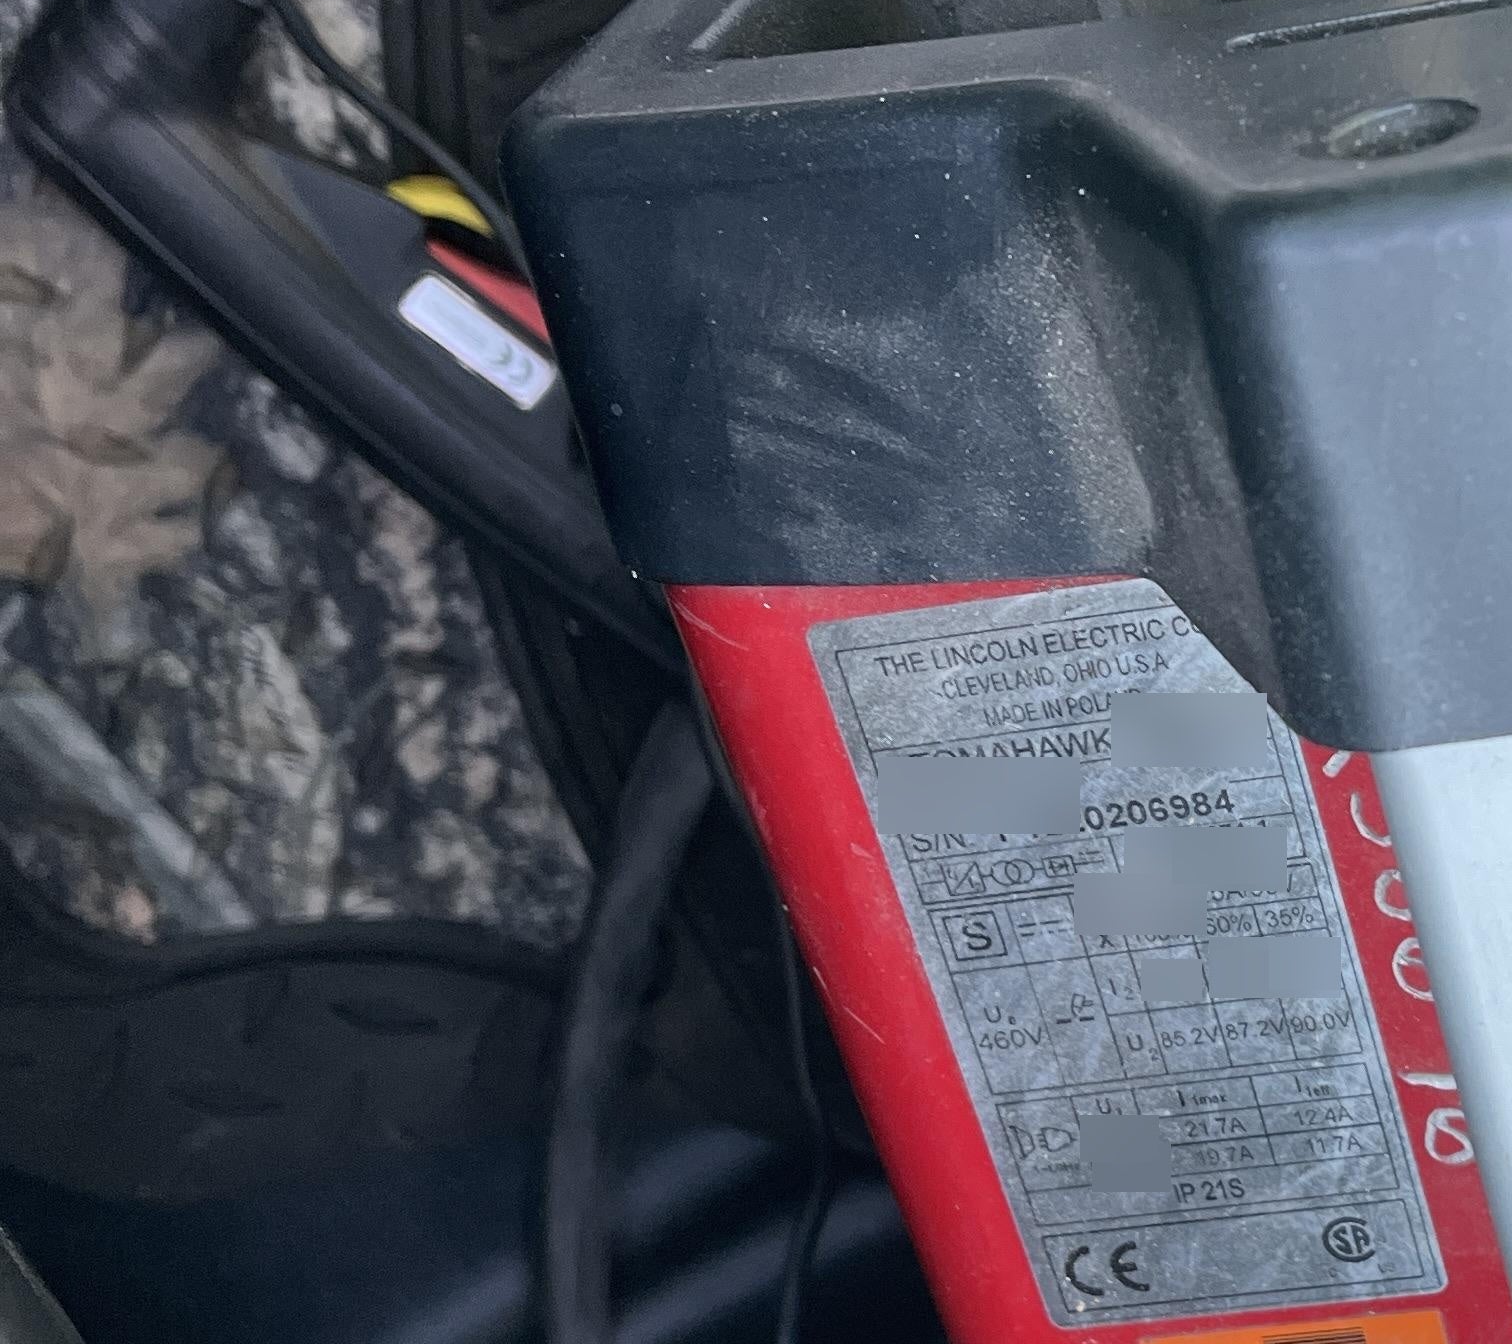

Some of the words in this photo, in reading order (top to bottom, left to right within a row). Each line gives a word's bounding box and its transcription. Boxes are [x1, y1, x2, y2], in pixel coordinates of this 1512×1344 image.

[875, 652, 928, 678] THE
[934, 636, 1038, 670] LINCOLN
[1045, 618, 1165, 656] ELECTRIC
[1064, 659, 1111, 683] OHIO
[984, 701, 1039, 726] MADE
[1042, 698, 1063, 719] IN
[1265, 904, 1314, 929] 35%
[962, 921, 993, 951] S
[978, 1026, 1042, 1051] 460V
[1185, 1116, 1248, 1137] 21.7A
[1174, 1183, 1196, 1203] IP
[1201, 1178, 1245, 1200] 21S
[1064, 1241, 1150, 1296] CE
